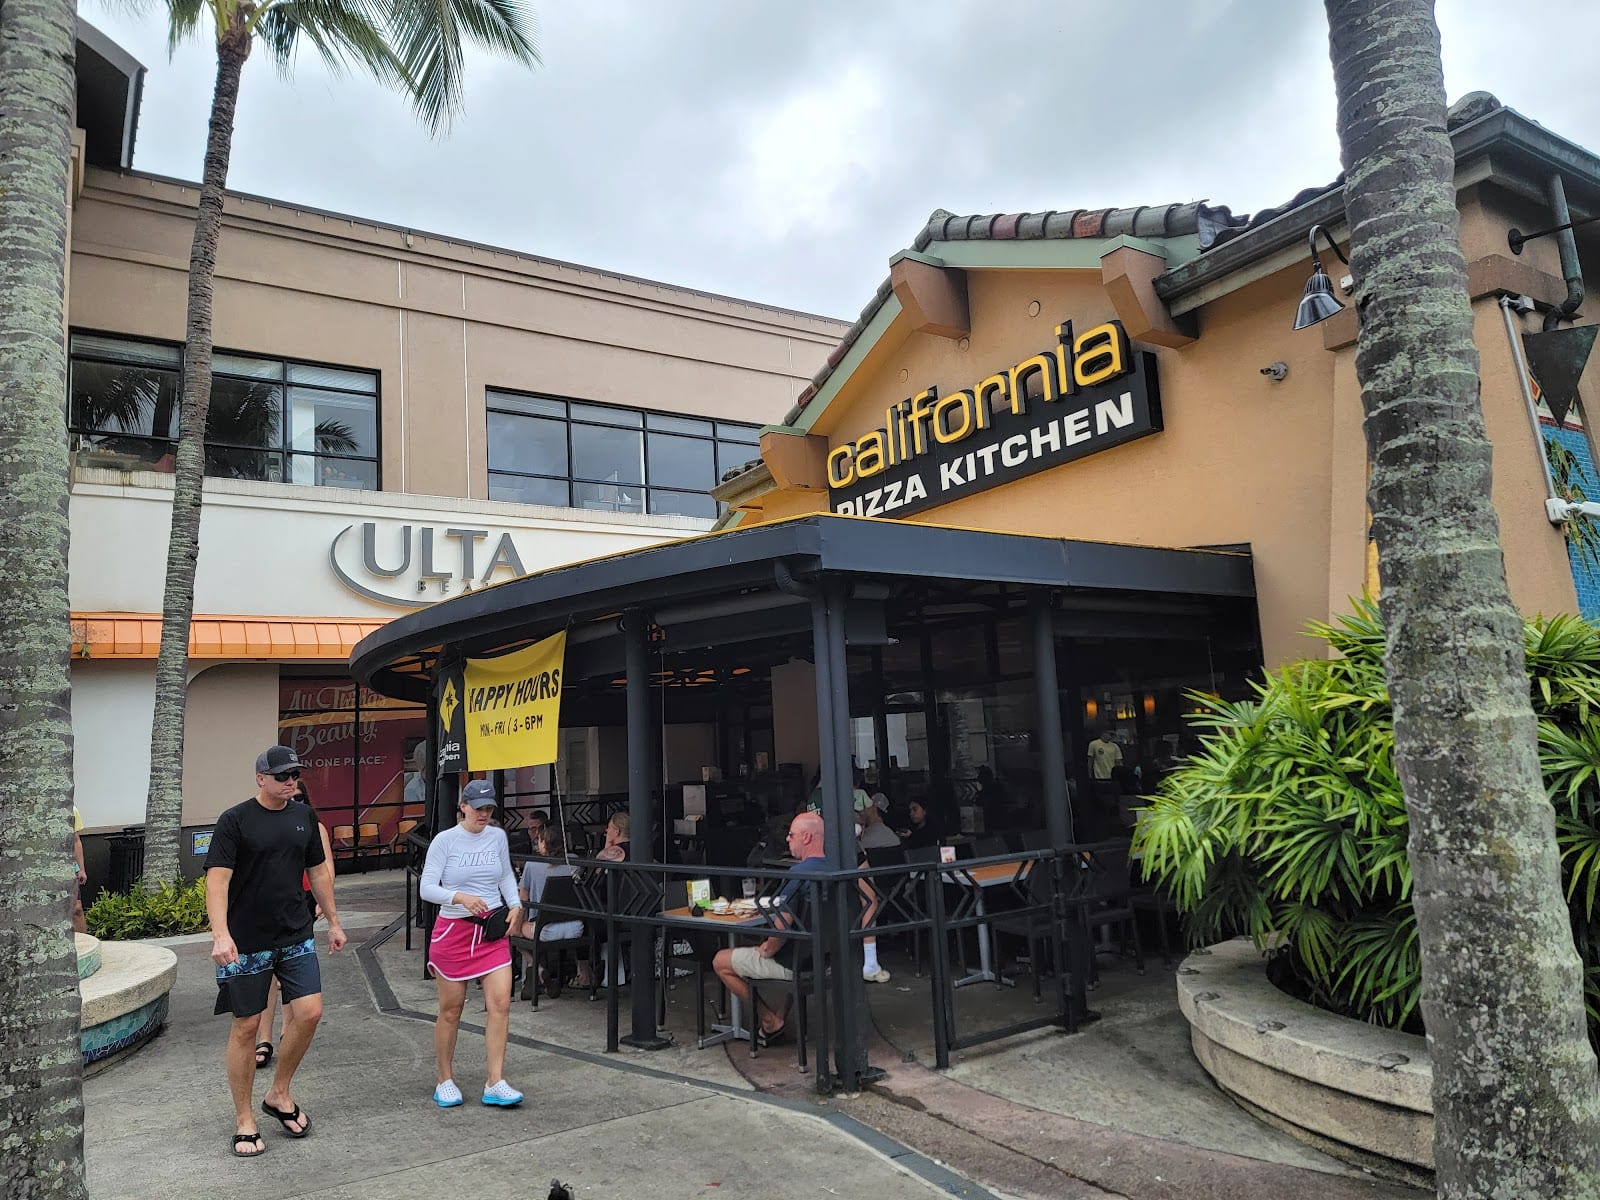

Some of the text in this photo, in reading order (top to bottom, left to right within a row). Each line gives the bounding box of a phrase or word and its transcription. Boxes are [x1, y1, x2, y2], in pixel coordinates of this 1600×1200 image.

[827, 321, 1128, 490] california
[837, 392, 1135, 518] PIZZA KITCHEN
[362, 522, 527, 582] ULTA
[417, 579, 489, 596] BEA
[513, 668, 560, 706] HOURS
[282, 720, 378, 757] Beauy.
[315, 757, 341, 767] ONE
[459, 850, 497, 867] NIKE
